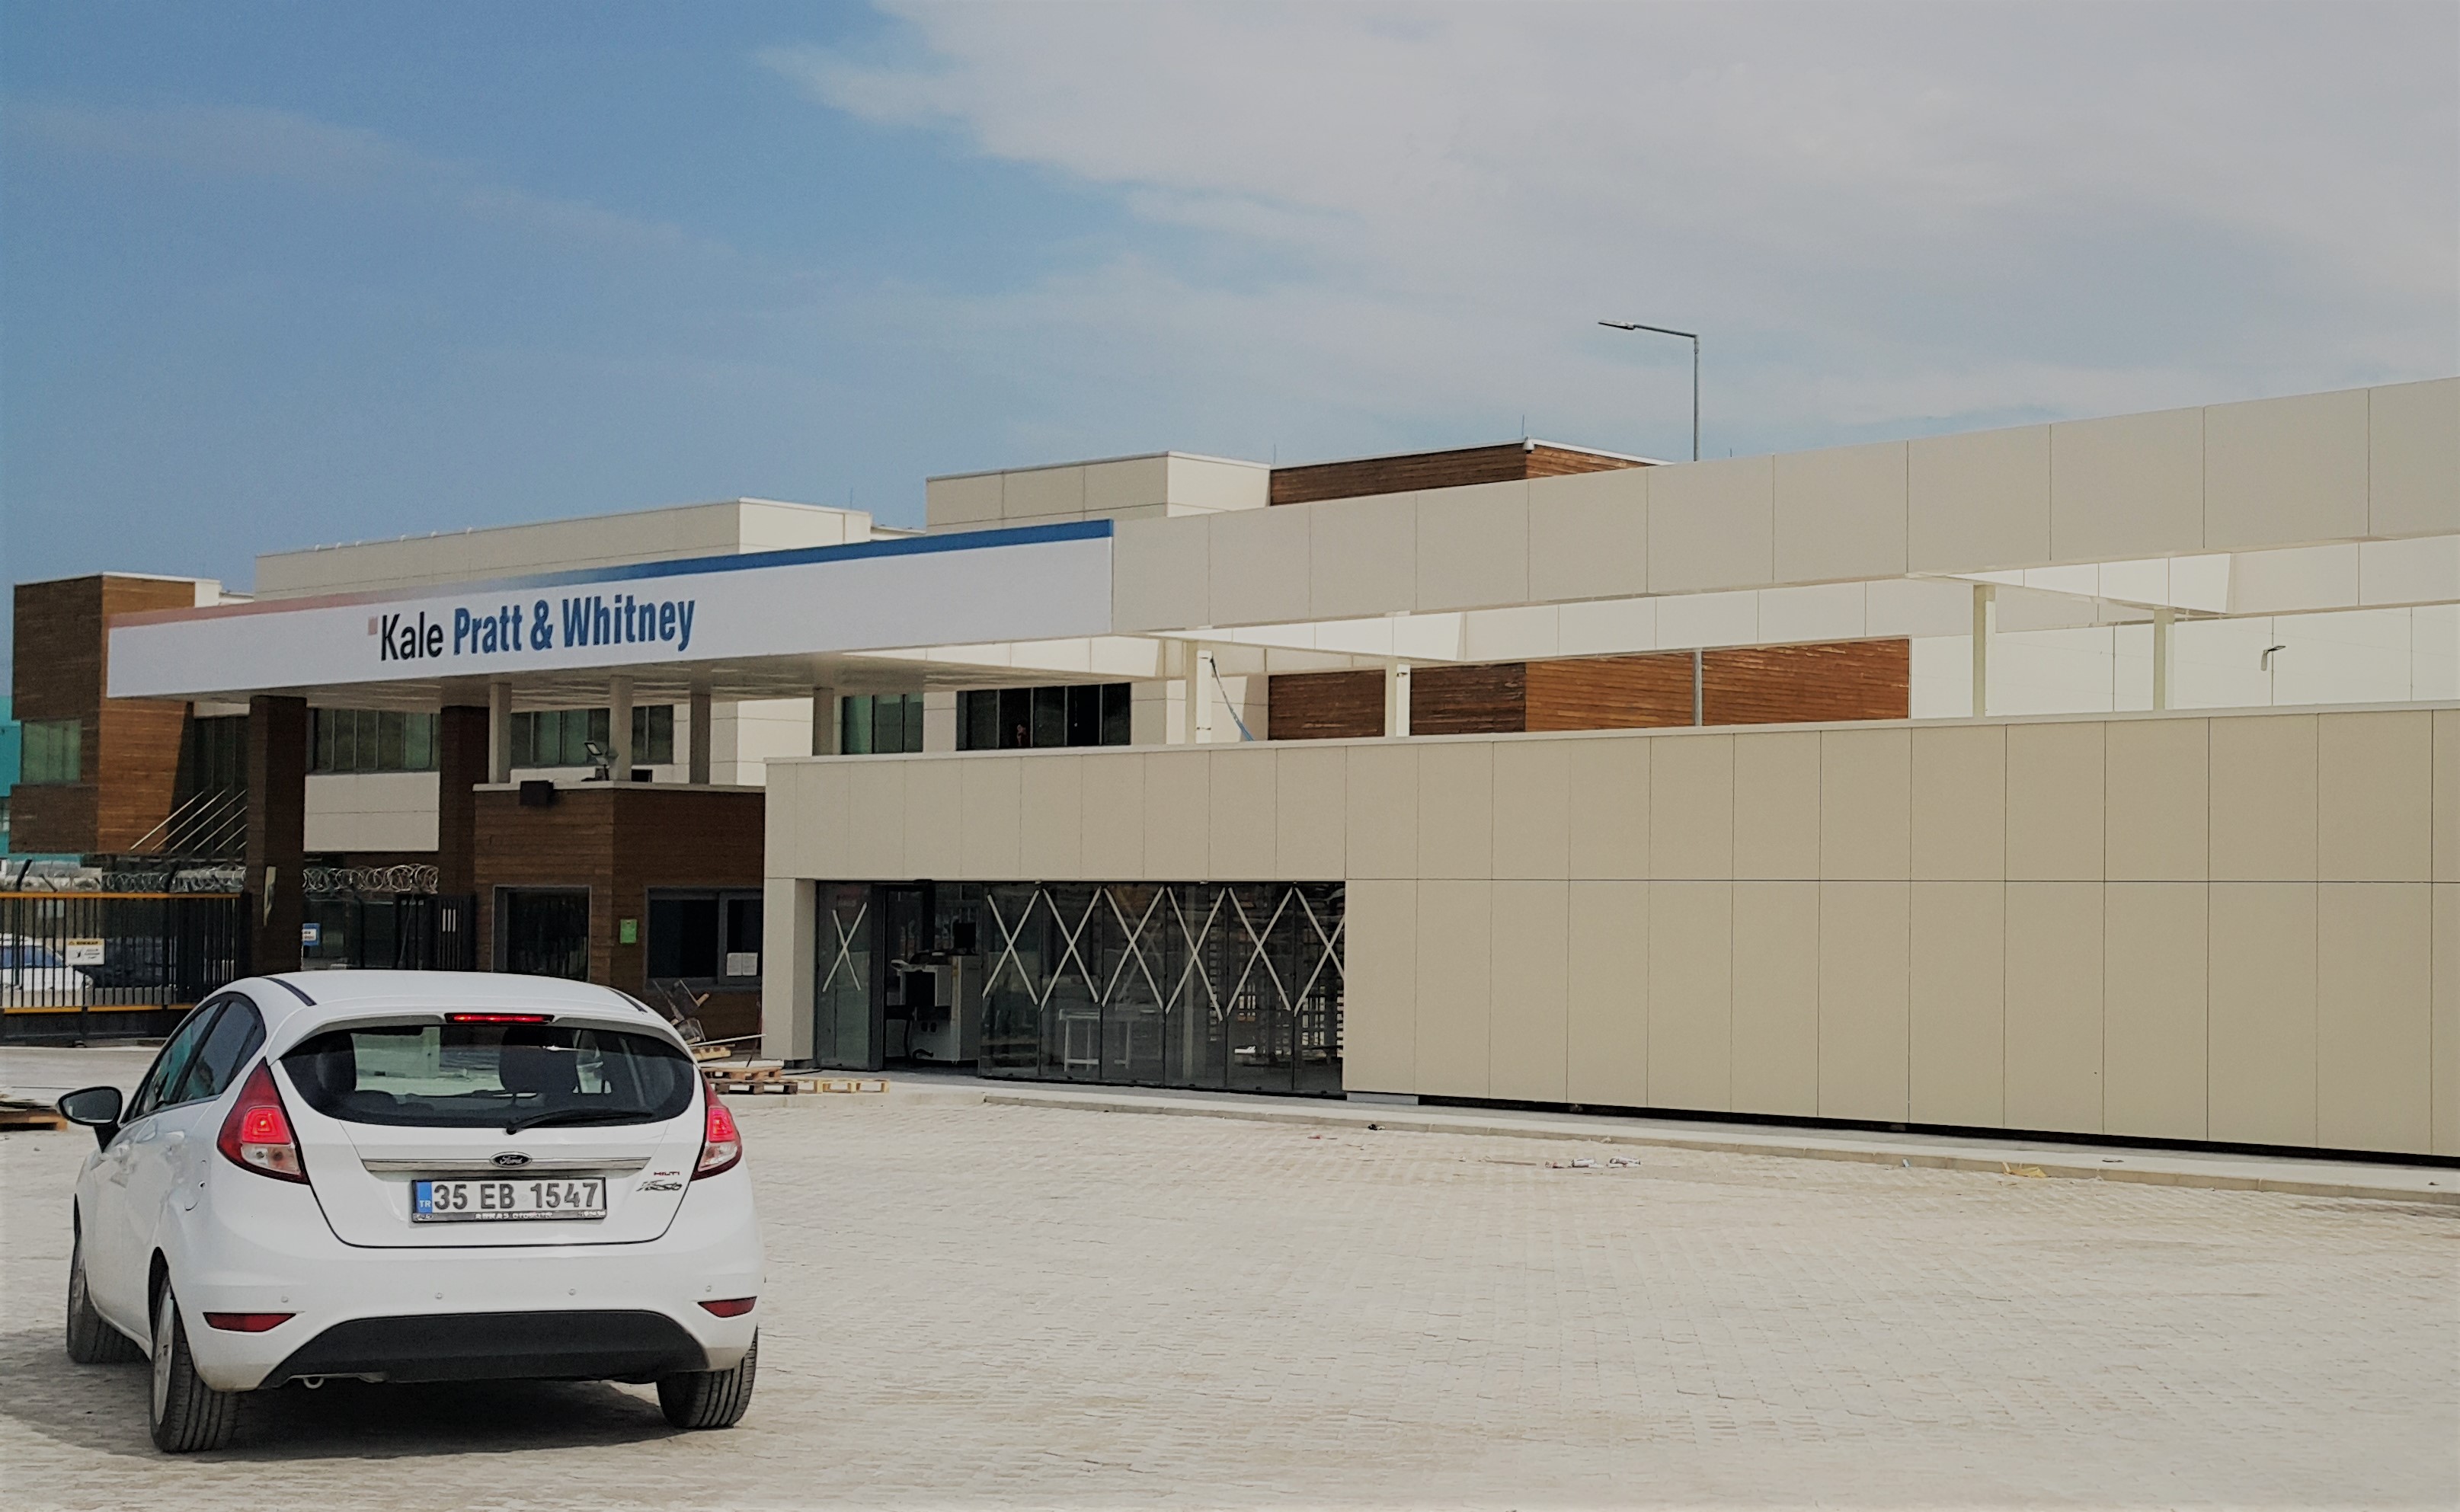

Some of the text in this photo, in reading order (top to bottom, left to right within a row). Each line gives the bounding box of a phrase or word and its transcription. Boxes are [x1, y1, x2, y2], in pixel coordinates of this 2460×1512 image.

[380, 594, 695, 661] Kale Pratt & Whitney
[419, 1200, 431, 1208] TR
[433, 1182, 598, 1210] 35 EB 1547
